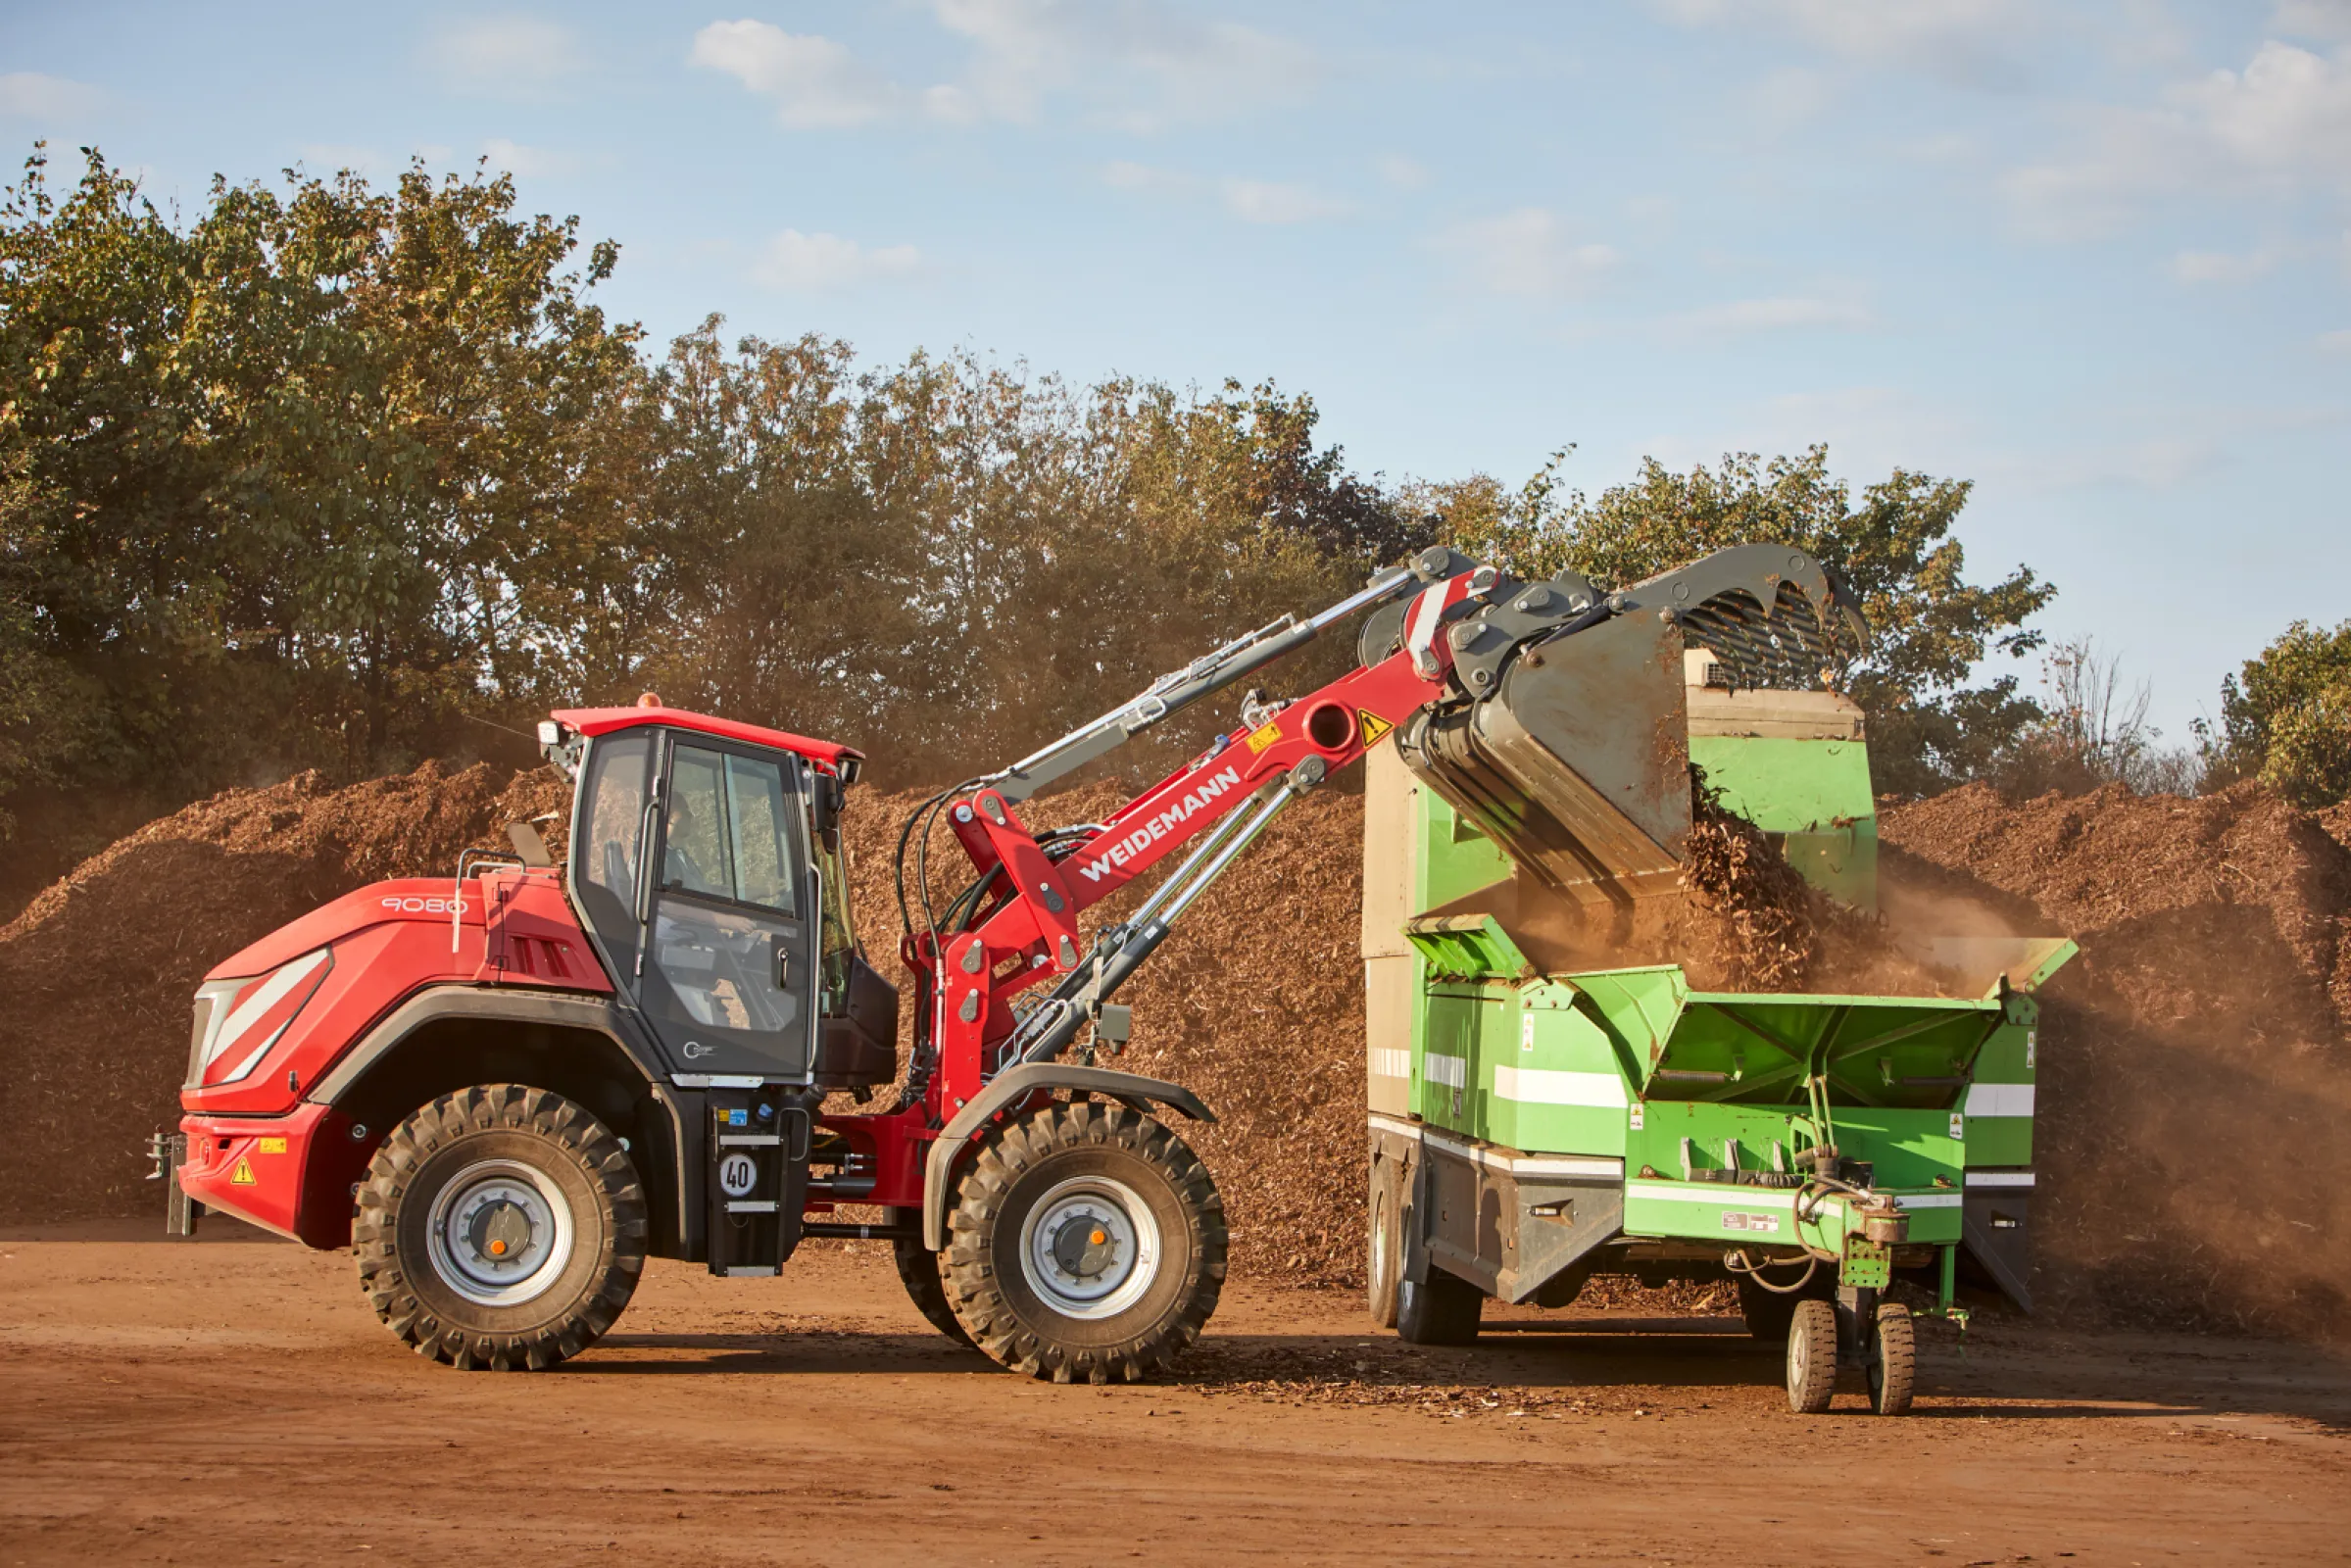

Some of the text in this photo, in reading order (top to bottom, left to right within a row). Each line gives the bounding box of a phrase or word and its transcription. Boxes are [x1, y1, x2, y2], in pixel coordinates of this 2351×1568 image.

[1080, 765, 1241, 882] WEIDEMANN
[381, 898, 468, 914] 9080
[726, 1161, 749, 1188] 40
